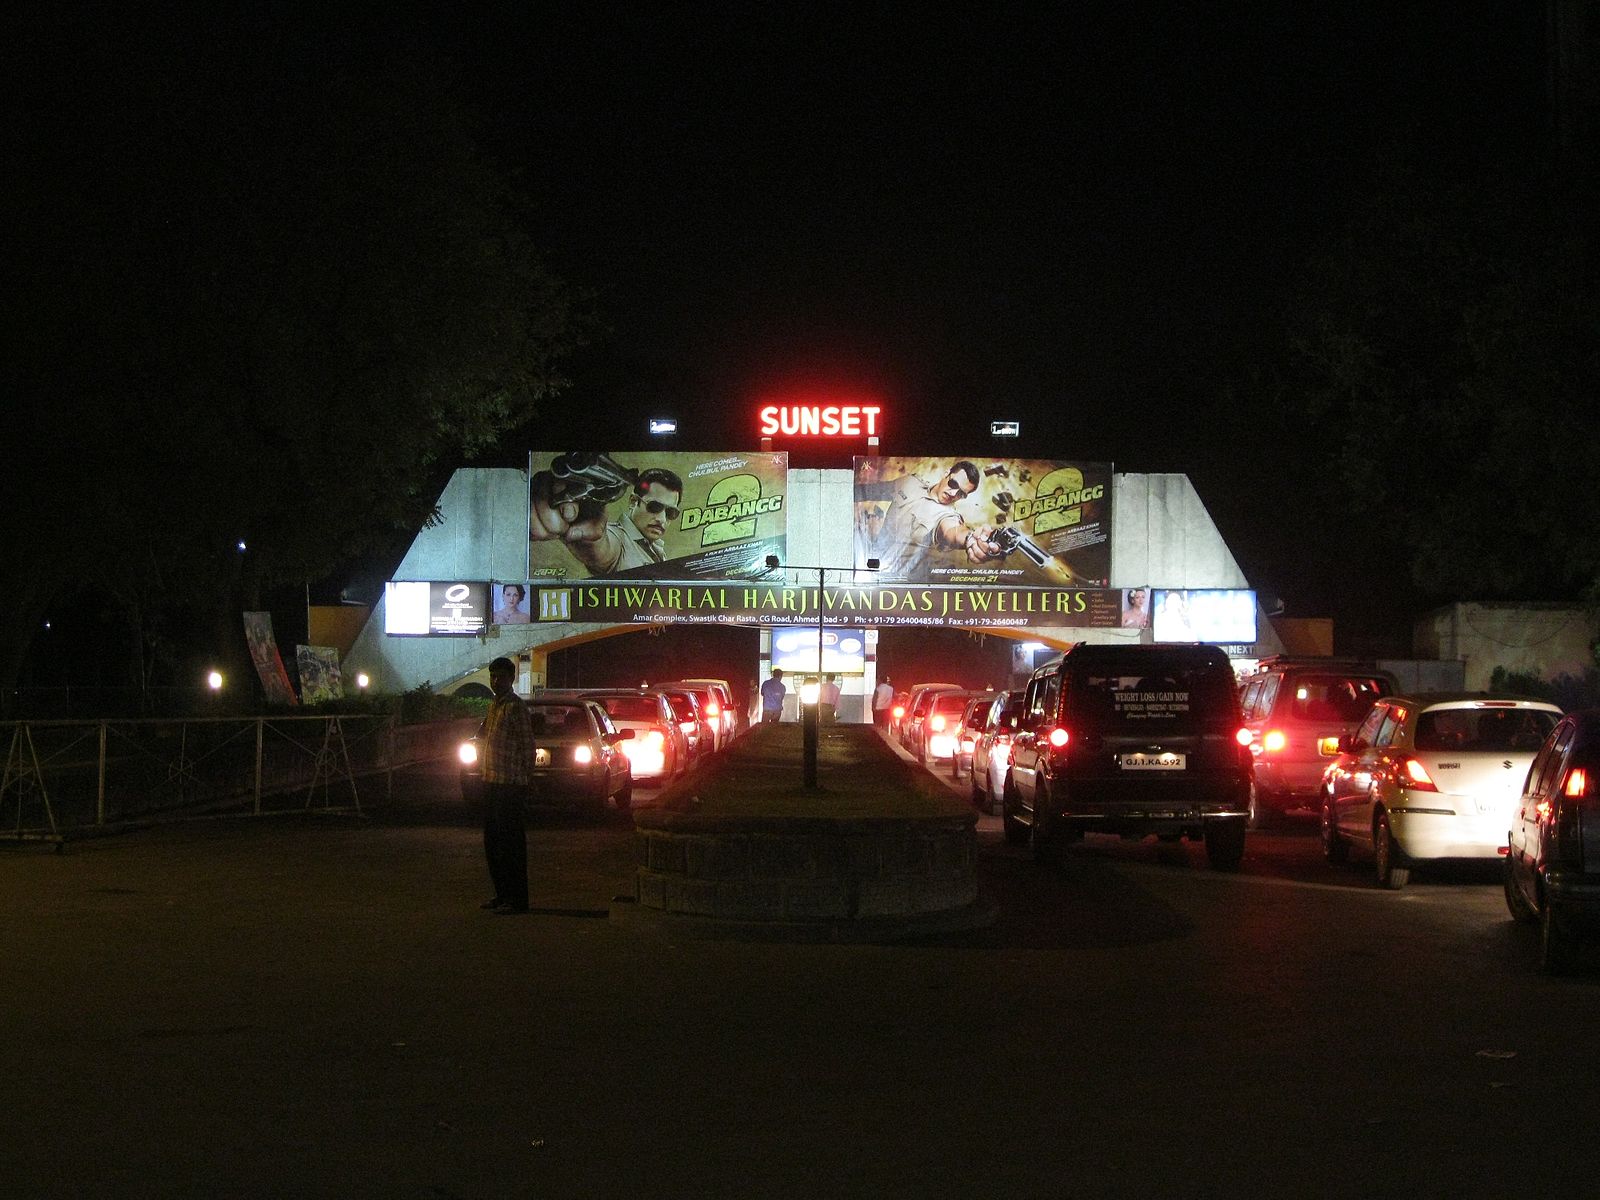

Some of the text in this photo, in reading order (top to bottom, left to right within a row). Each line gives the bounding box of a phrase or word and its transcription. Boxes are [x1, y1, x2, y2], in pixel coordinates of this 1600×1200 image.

[760, 406, 881, 435] SUNSET
[688, 460, 749, 478] CHULBUL PANDEY
[695, 461, 712, 471] HERE
[680, 495, 783, 531] DABANGG
[701, 473, 762, 548] 2
[1013, 484, 1104, 522] DABANGG
[1033, 466, 1085, 537] 2
[987, 575, 998, 583] 21
[578, 587, 1086, 616] ISHWARLAL HARJIVANDAS JEWELLERS
[633, 614, 652, 622] Amar
[654, 613, 688, 624] Complex,
[689, 614, 717, 622] Swastik
[717, 614, 735, 623] Char
[736, 615, 758, 624] Rasta,
[760, 615, 770, 623] CG
[771, 615, 792, 624] Road,
[793, 615, 838, 624] Ahmedbad
[843, 616, 848, 624] 9
[854, 616, 866, 624] Ph:
[874, 616, 895, 624] 91-79
[896, 616, 944, 625] 26400485/86
[948, 617, 963, 626] Fax:
[965, 617, 1028, 626] +91-79-26400487
[1229, 645, 1254, 655] NEXT
[1114, 692, 1139, 702] WEIGHT
[1175, 692, 1189, 702] NOW
